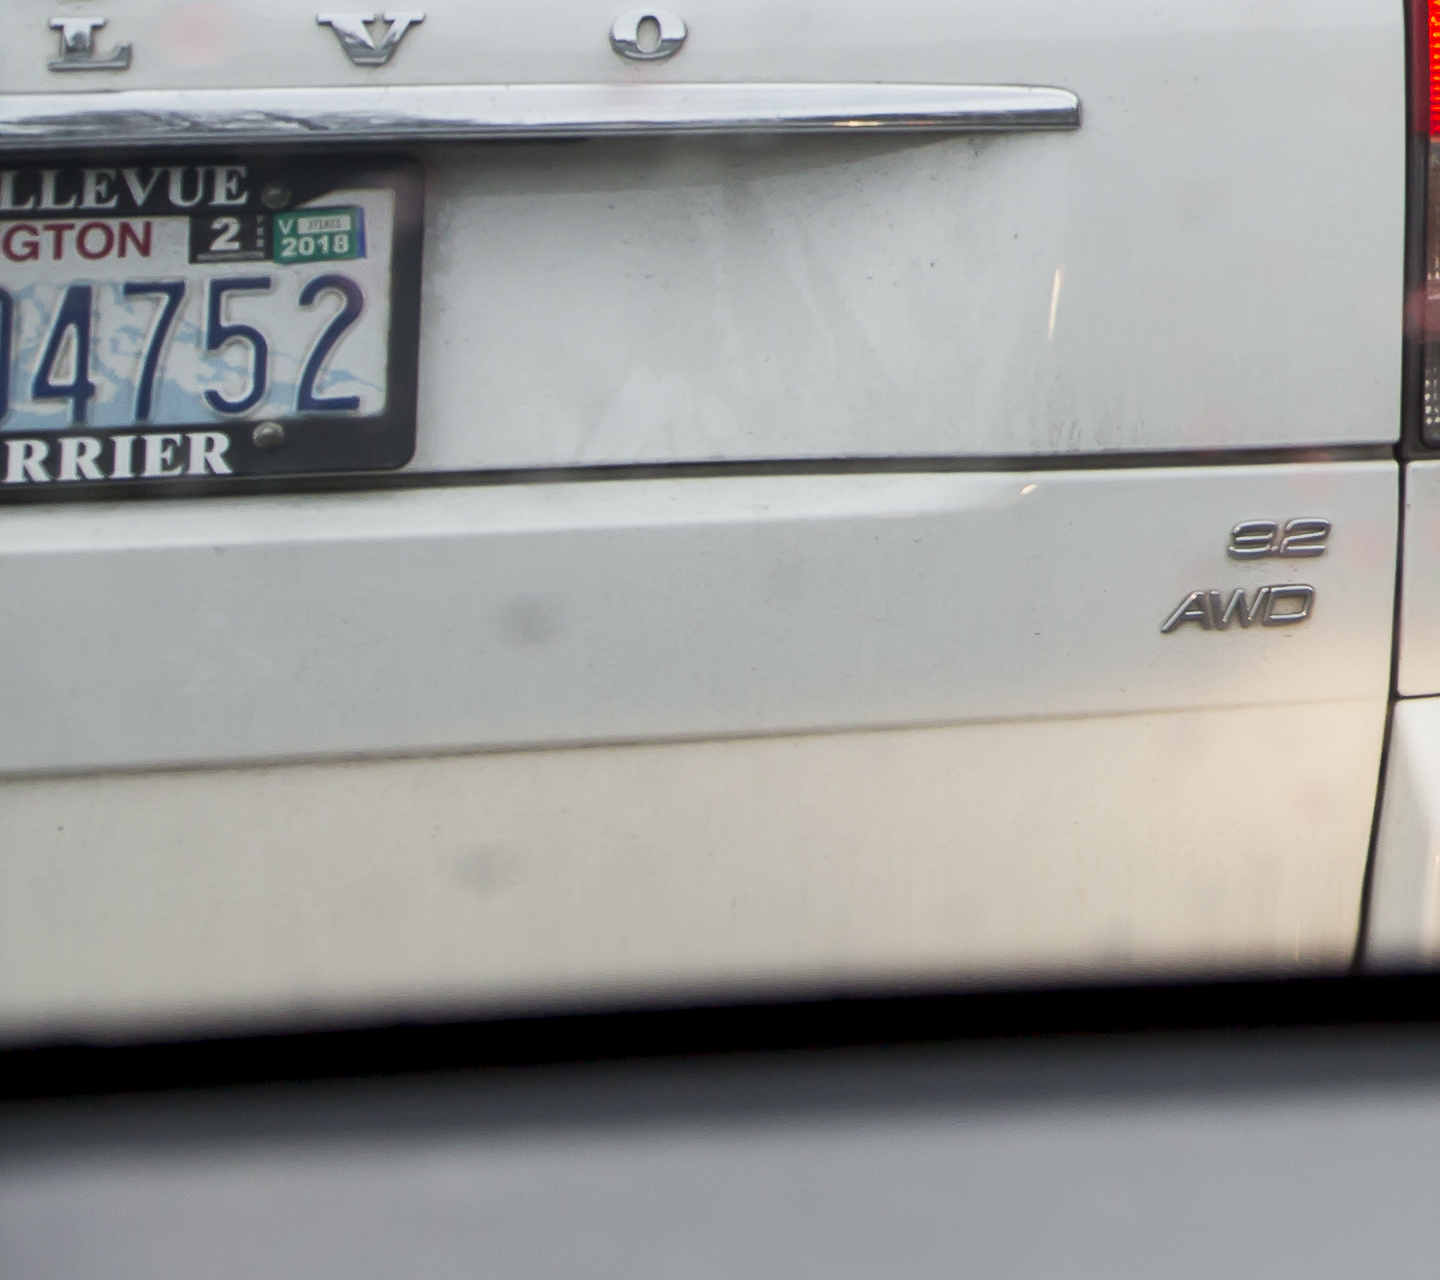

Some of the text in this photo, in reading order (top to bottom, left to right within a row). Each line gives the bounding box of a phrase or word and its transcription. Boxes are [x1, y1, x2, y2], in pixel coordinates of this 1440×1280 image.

[2, 221, 153, 262] GTON
[210, 217, 240, 251] 2
[281, 233, 350, 257] 2018
[2, 431, 233, 484] RRIER
[1160, 583, 1316, 633] AWD
